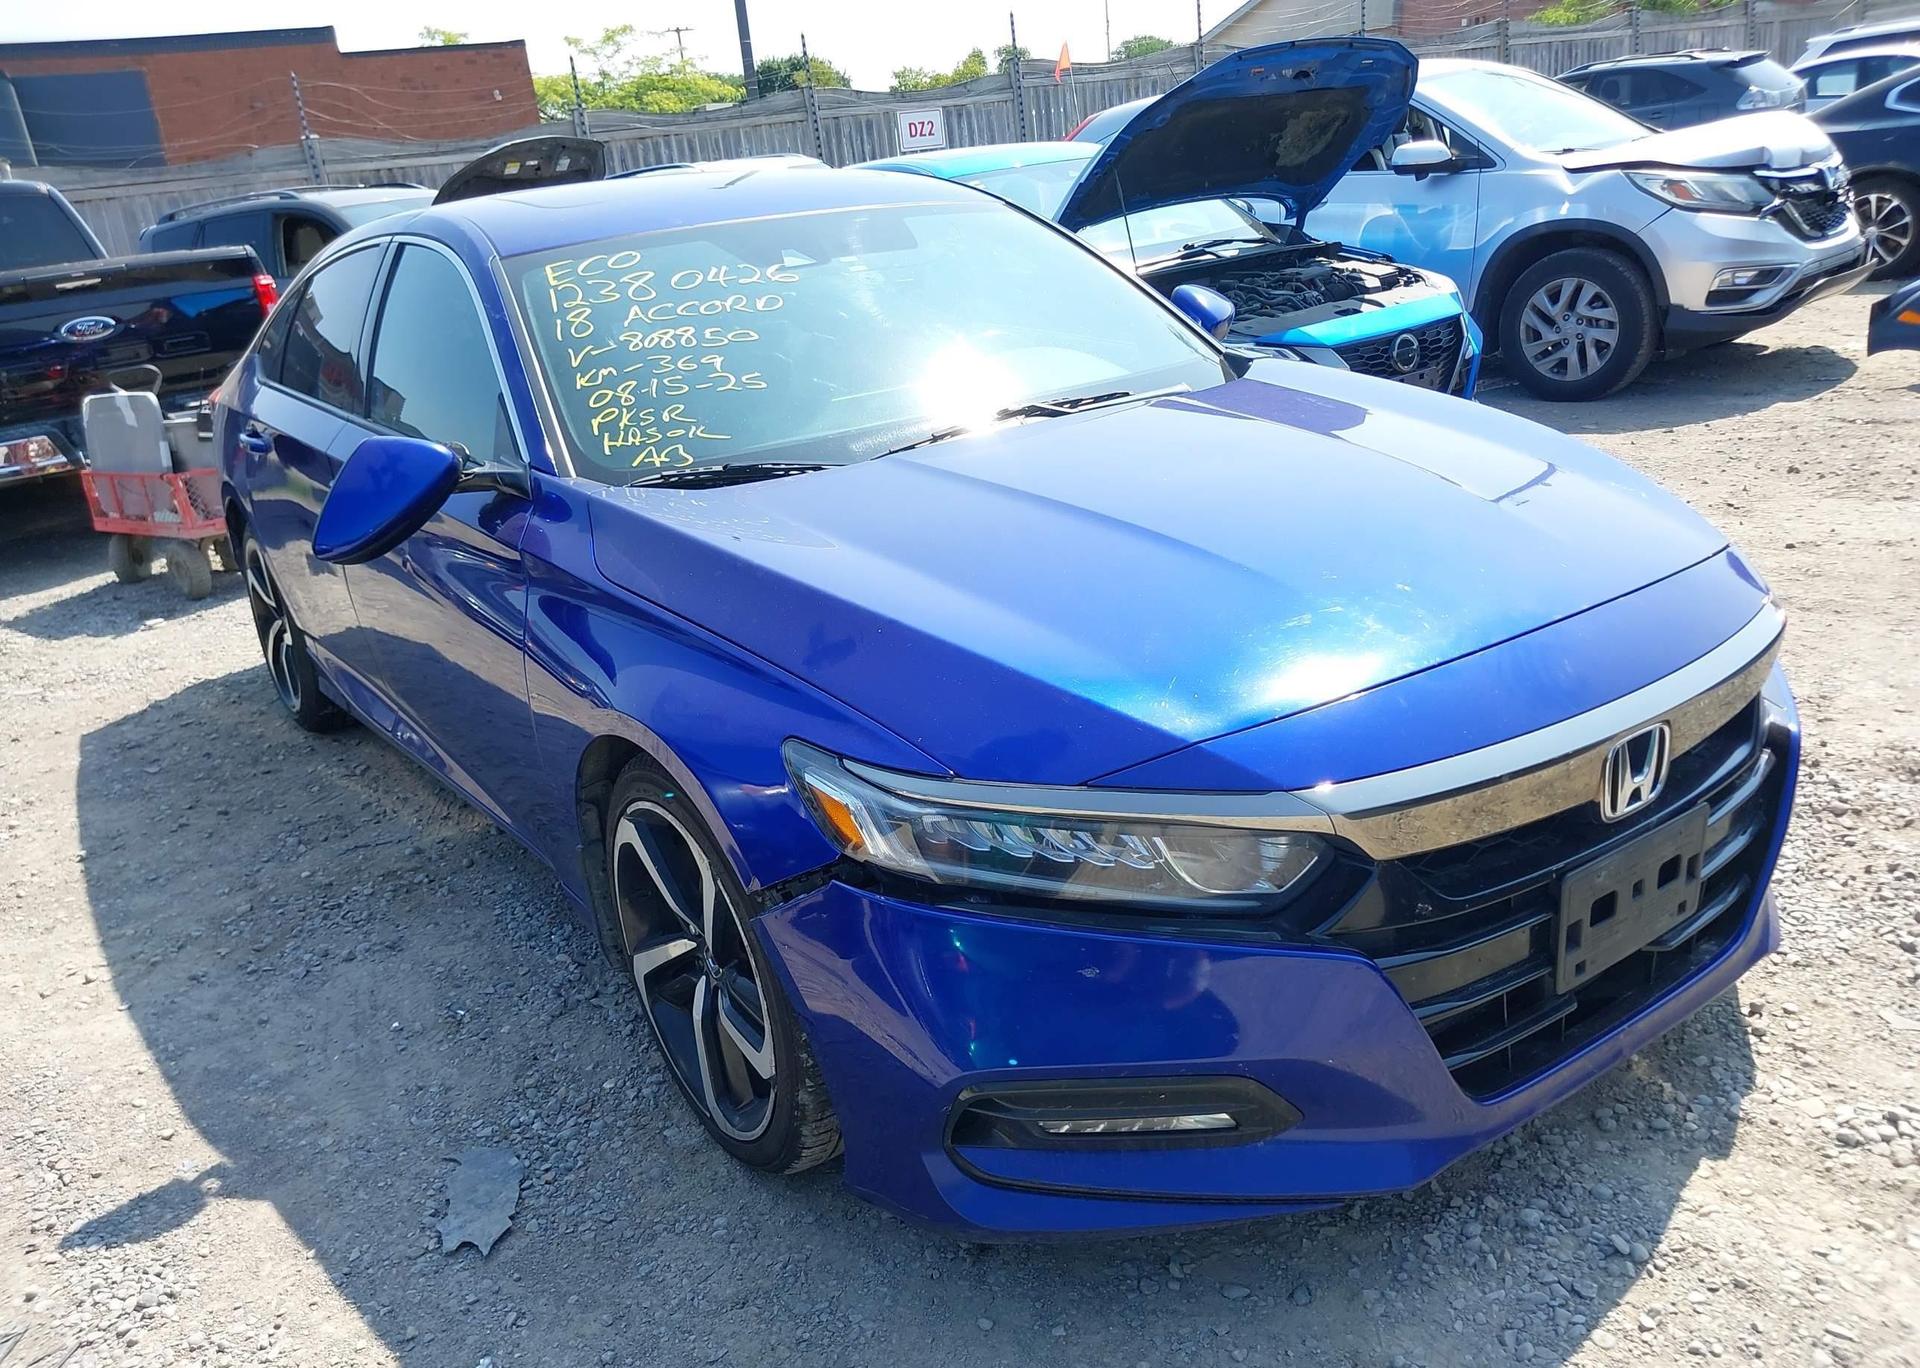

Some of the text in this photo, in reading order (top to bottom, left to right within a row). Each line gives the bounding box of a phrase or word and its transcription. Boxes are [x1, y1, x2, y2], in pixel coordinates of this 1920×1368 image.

[908, 120, 936, 138] DZ2
[544, 250, 642, 287] ECO
[549, 263, 801, 314] 1238 0426
[555, 294, 785, 342] 18 ACCORD
